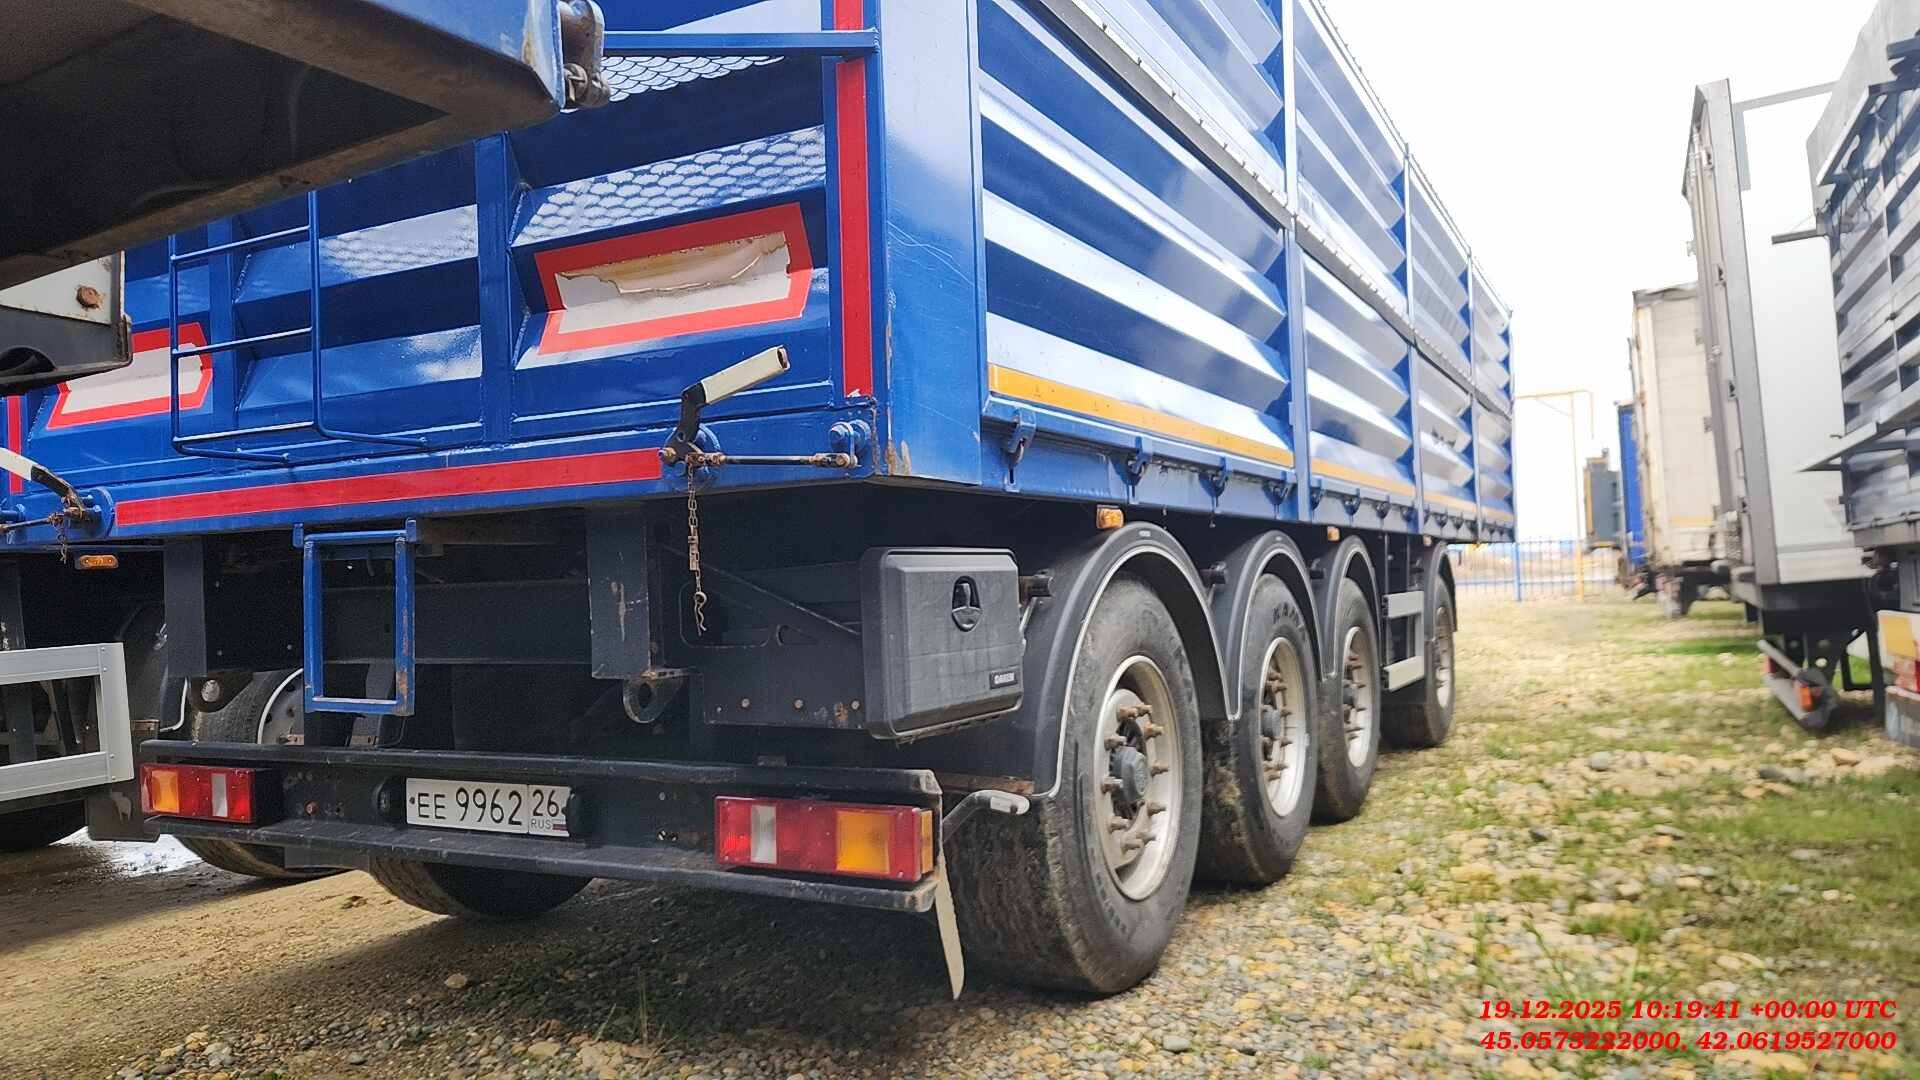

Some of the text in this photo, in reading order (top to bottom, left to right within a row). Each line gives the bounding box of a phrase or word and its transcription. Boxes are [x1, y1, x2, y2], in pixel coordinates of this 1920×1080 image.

[456, 787, 523, 826] 9962
[532, 789, 560, 818] 26
[530, 818, 552, 830] RUS
